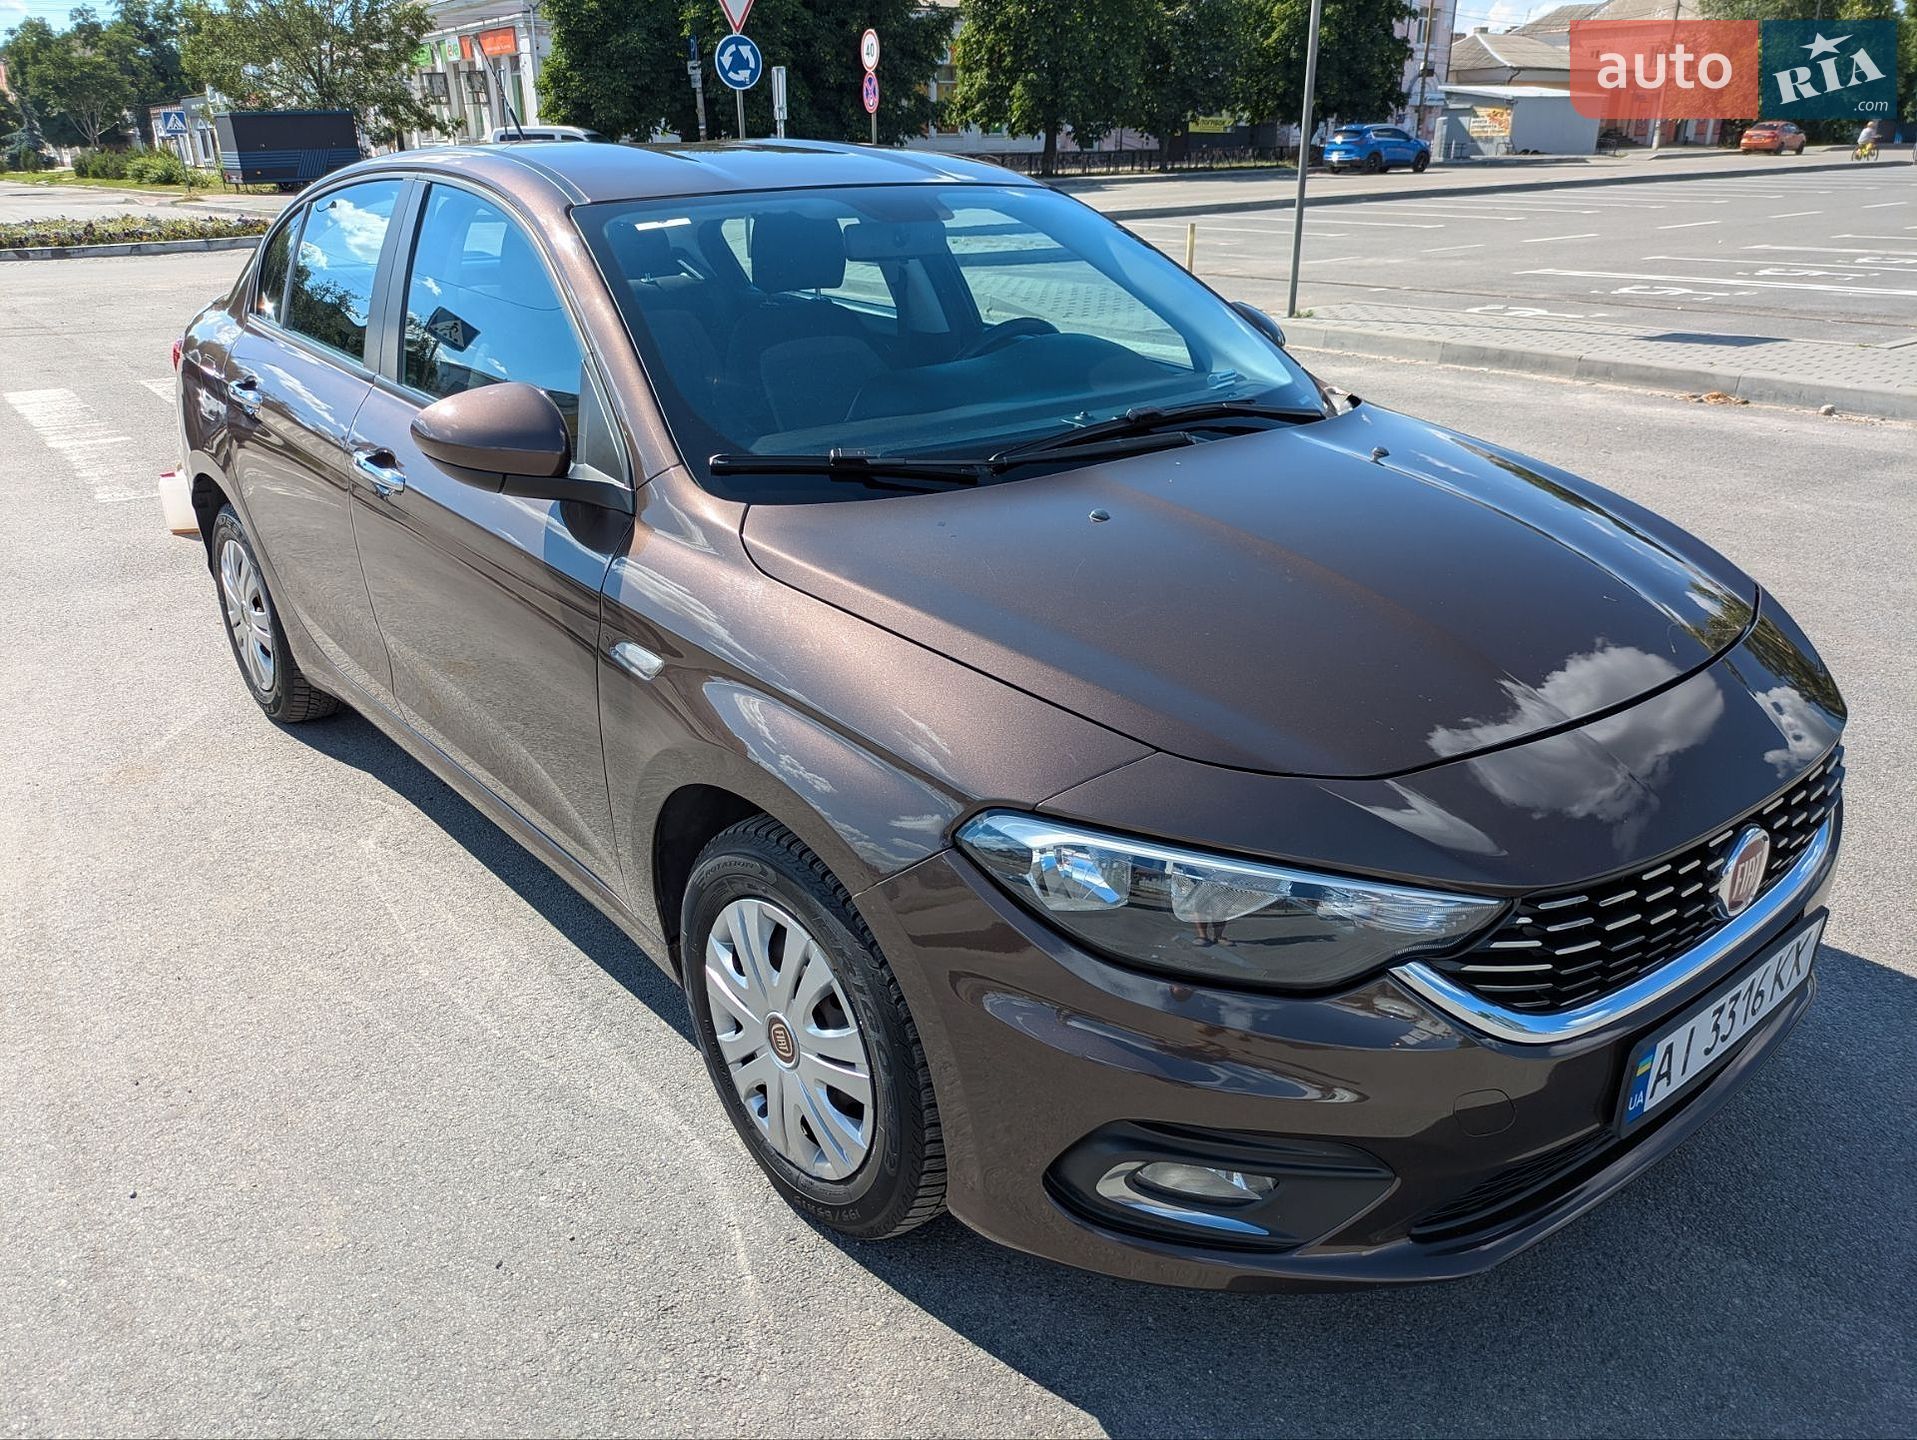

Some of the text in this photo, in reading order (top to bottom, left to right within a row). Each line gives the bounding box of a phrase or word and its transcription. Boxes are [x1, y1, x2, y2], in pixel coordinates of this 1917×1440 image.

[865, 43, 875, 58] 40
[705, 860, 754, 878] ROTATION
[1732, 850, 1763, 900] FIAT
[1649, 931, 1815, 1099] AI 3316 KX
[774, 1030, 789, 1052] FIAT
[1628, 1091, 1645, 1111] UA
